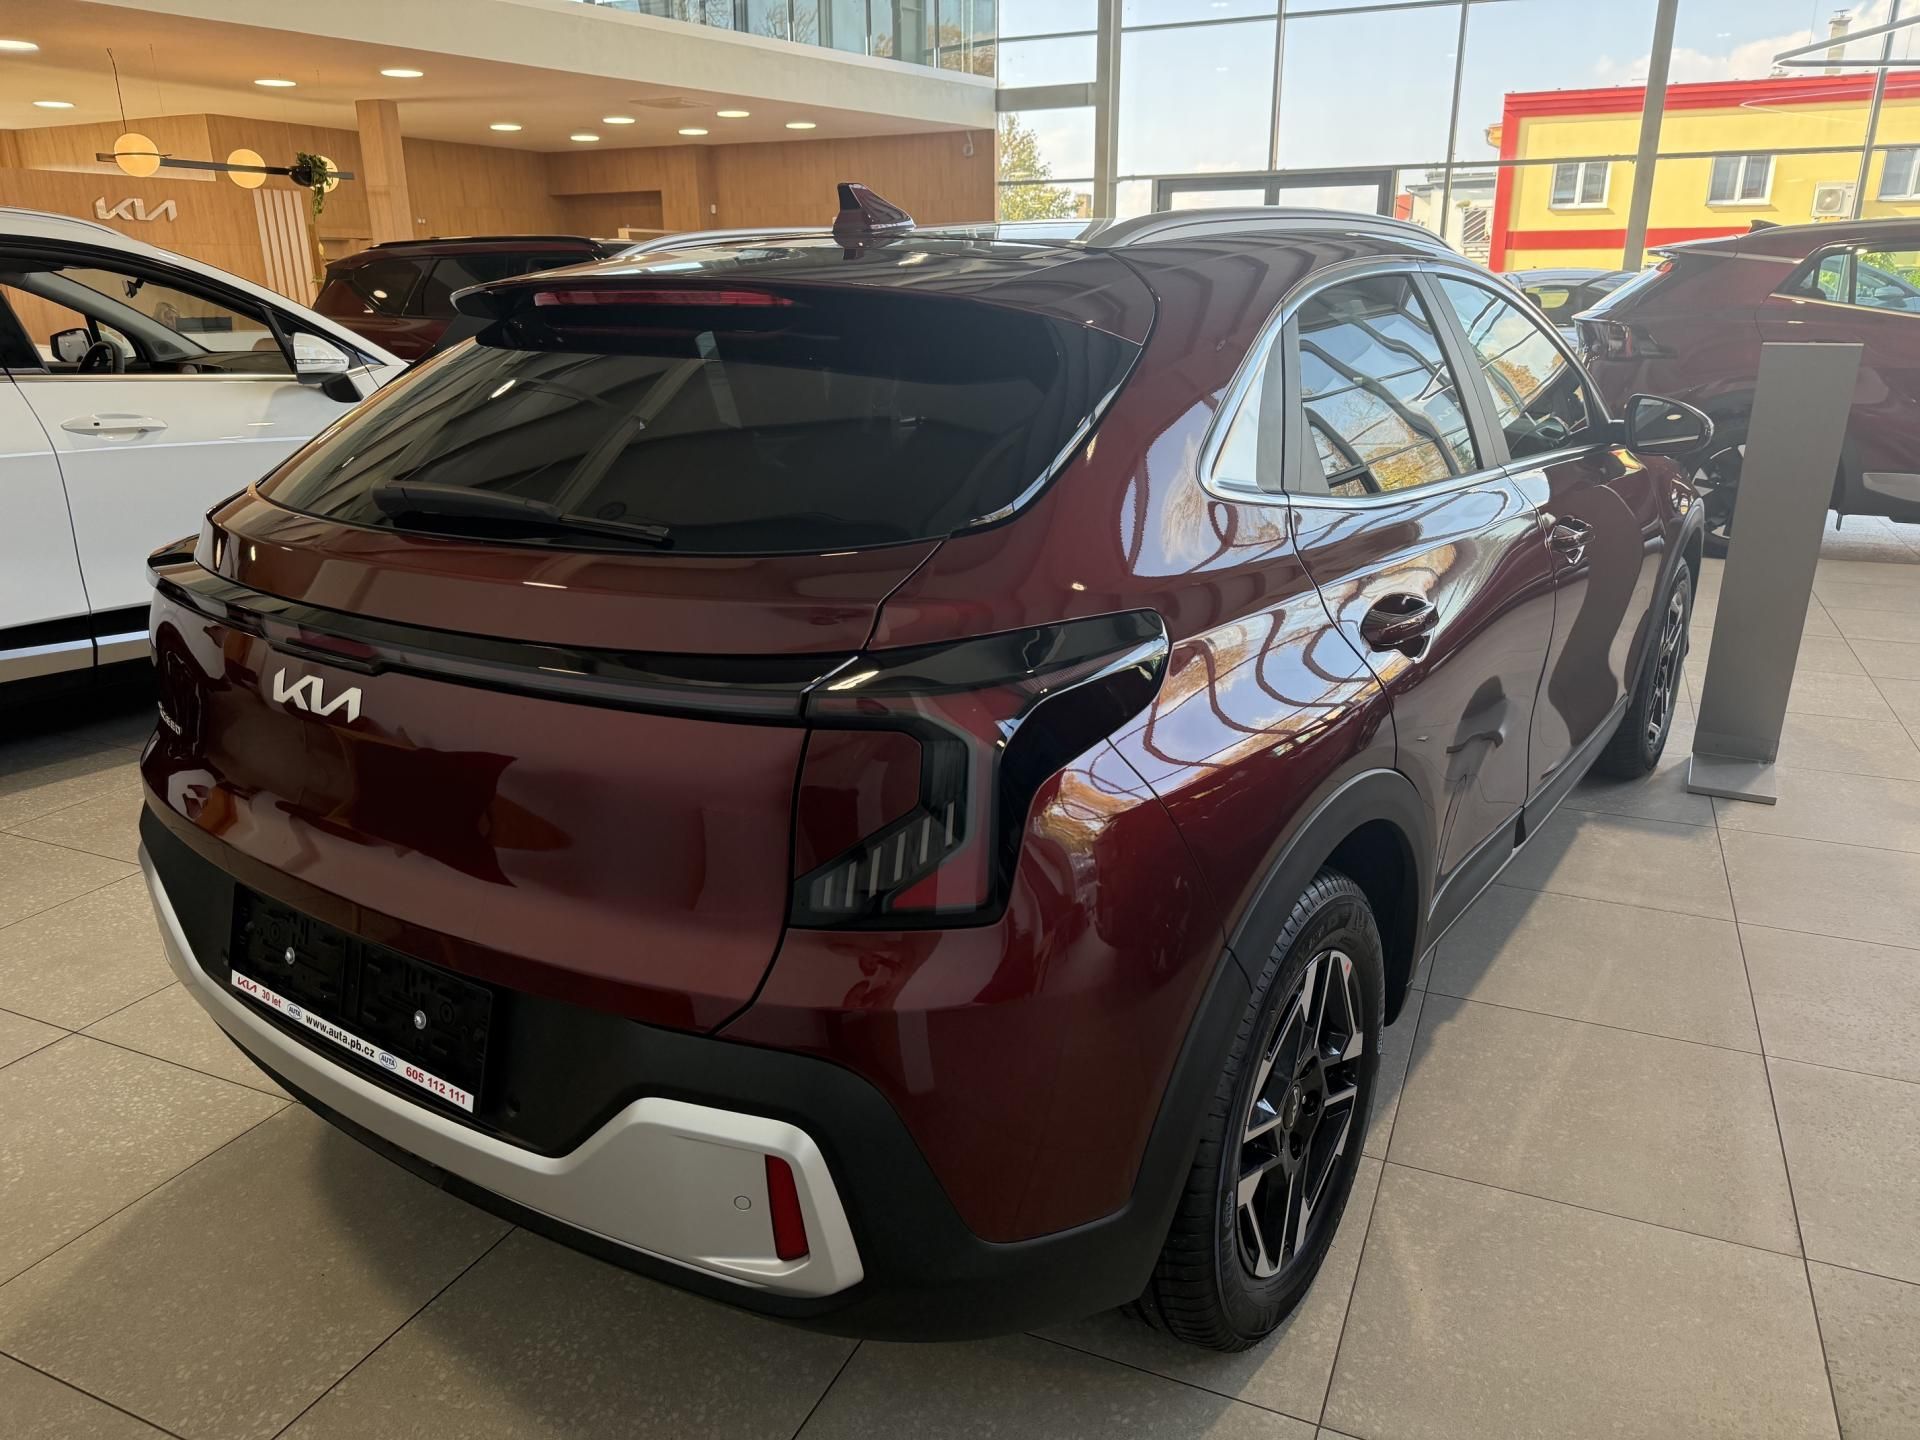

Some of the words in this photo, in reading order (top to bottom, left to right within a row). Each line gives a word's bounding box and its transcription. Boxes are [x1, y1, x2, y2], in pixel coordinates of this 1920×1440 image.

[95, 196, 178, 222] KIA
[273, 667, 362, 724] KIA
[237, 976, 257, 993] KIA
[262, 989, 270, 1001] 30
[272, 995, 281, 1008] let
[289, 1006, 301, 1017] AUTA
[306, 1015, 375, 1058] www.auta.pb.cz
[381, 1055, 395, 1067] AUTA
[406, 1066, 424, 1083] 605
[427, 1077, 446, 1094] 112
[449, 1088, 466, 1105] 111
